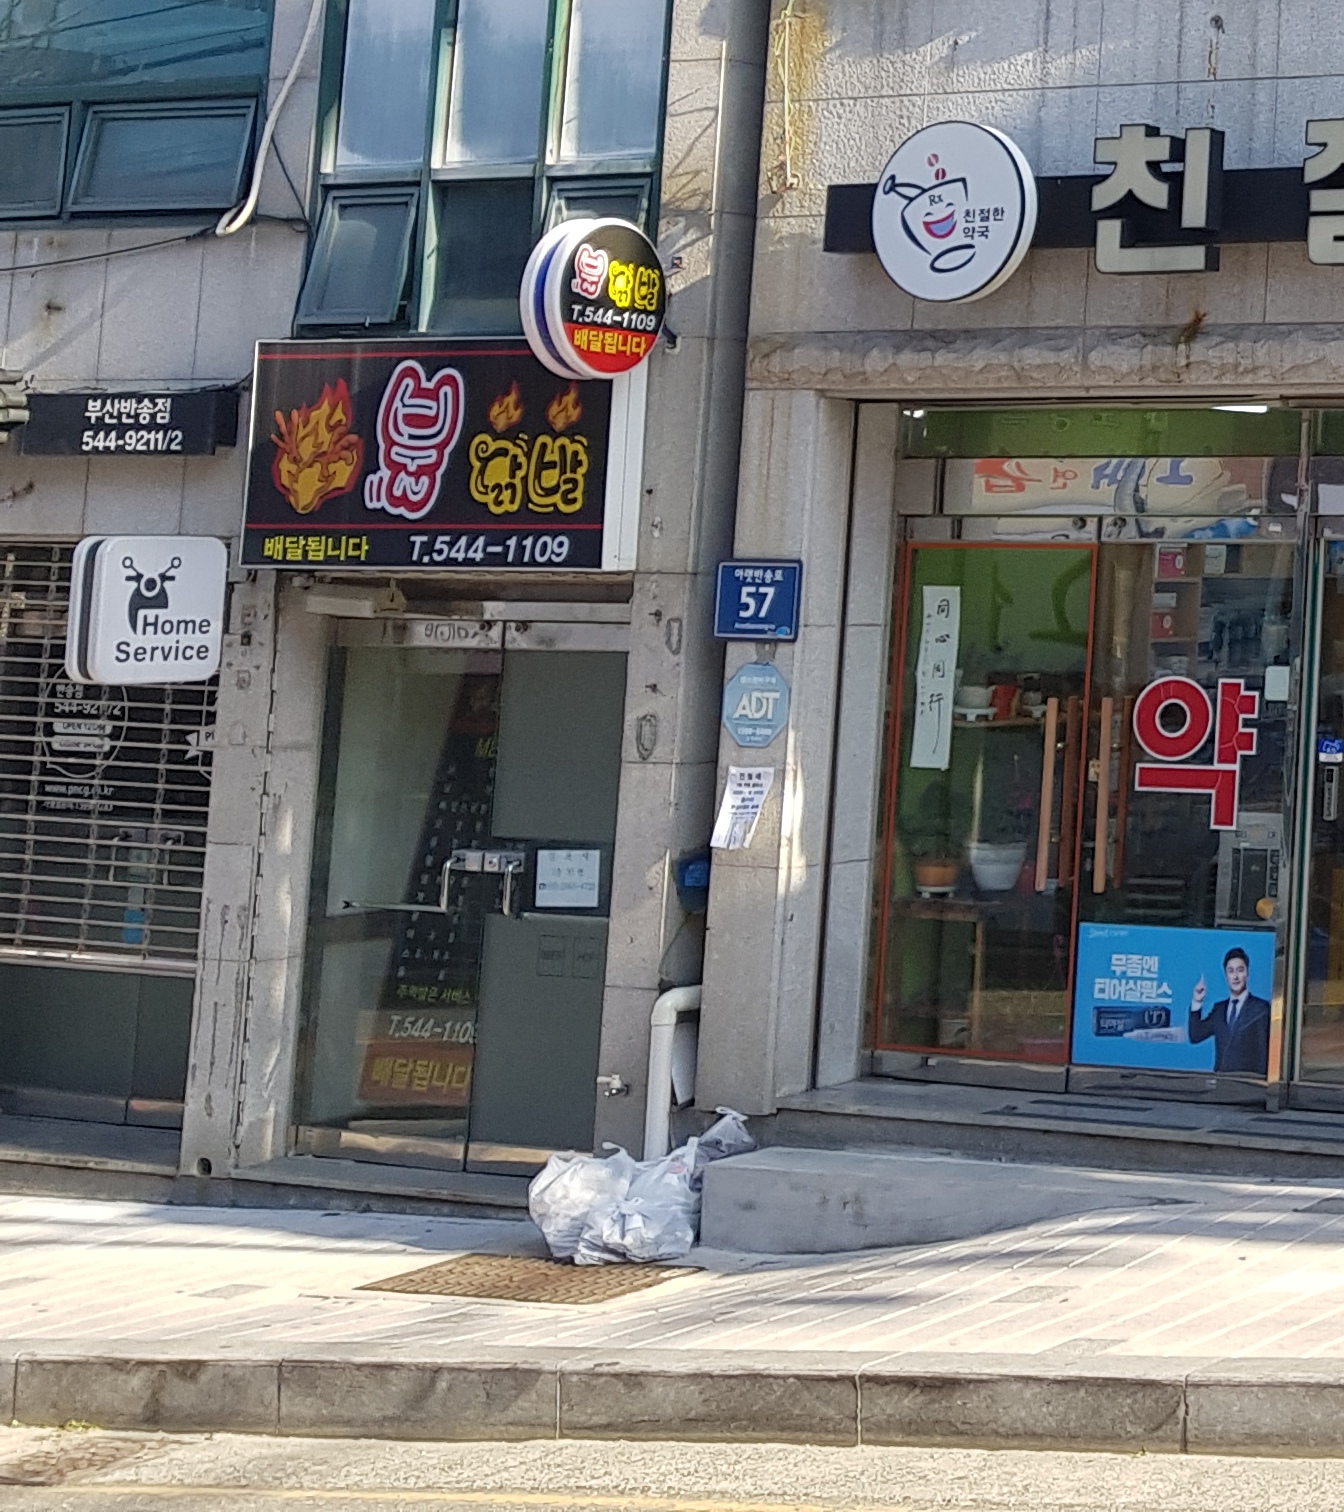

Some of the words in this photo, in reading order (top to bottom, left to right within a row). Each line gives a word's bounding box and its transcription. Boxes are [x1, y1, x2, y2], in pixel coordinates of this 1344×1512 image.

[962, 206, 1005, 223] 친절한
[962, 225, 990, 241] 약국
[571, 304, 656, 331] T.544-1109
[573, 328, 647, 358] 배달됩니다
[84, 398, 172, 425] 부산반송점
[81, 429, 184, 453] 544-9211/2
[263, 535, 369, 562] 배달됩니다
[409, 534, 570, 565] T.544-1109
[738, 586, 775, 618] 57
[142, 613, 211, 636] Home
[114, 640, 210, 664] Service
[53, 701, 122, 716] 544-92/2
[732, 690, 780, 720] ADT
[1132, 675, 1260, 831] 약
[1110, 953, 1159, 978] 무좀엔
